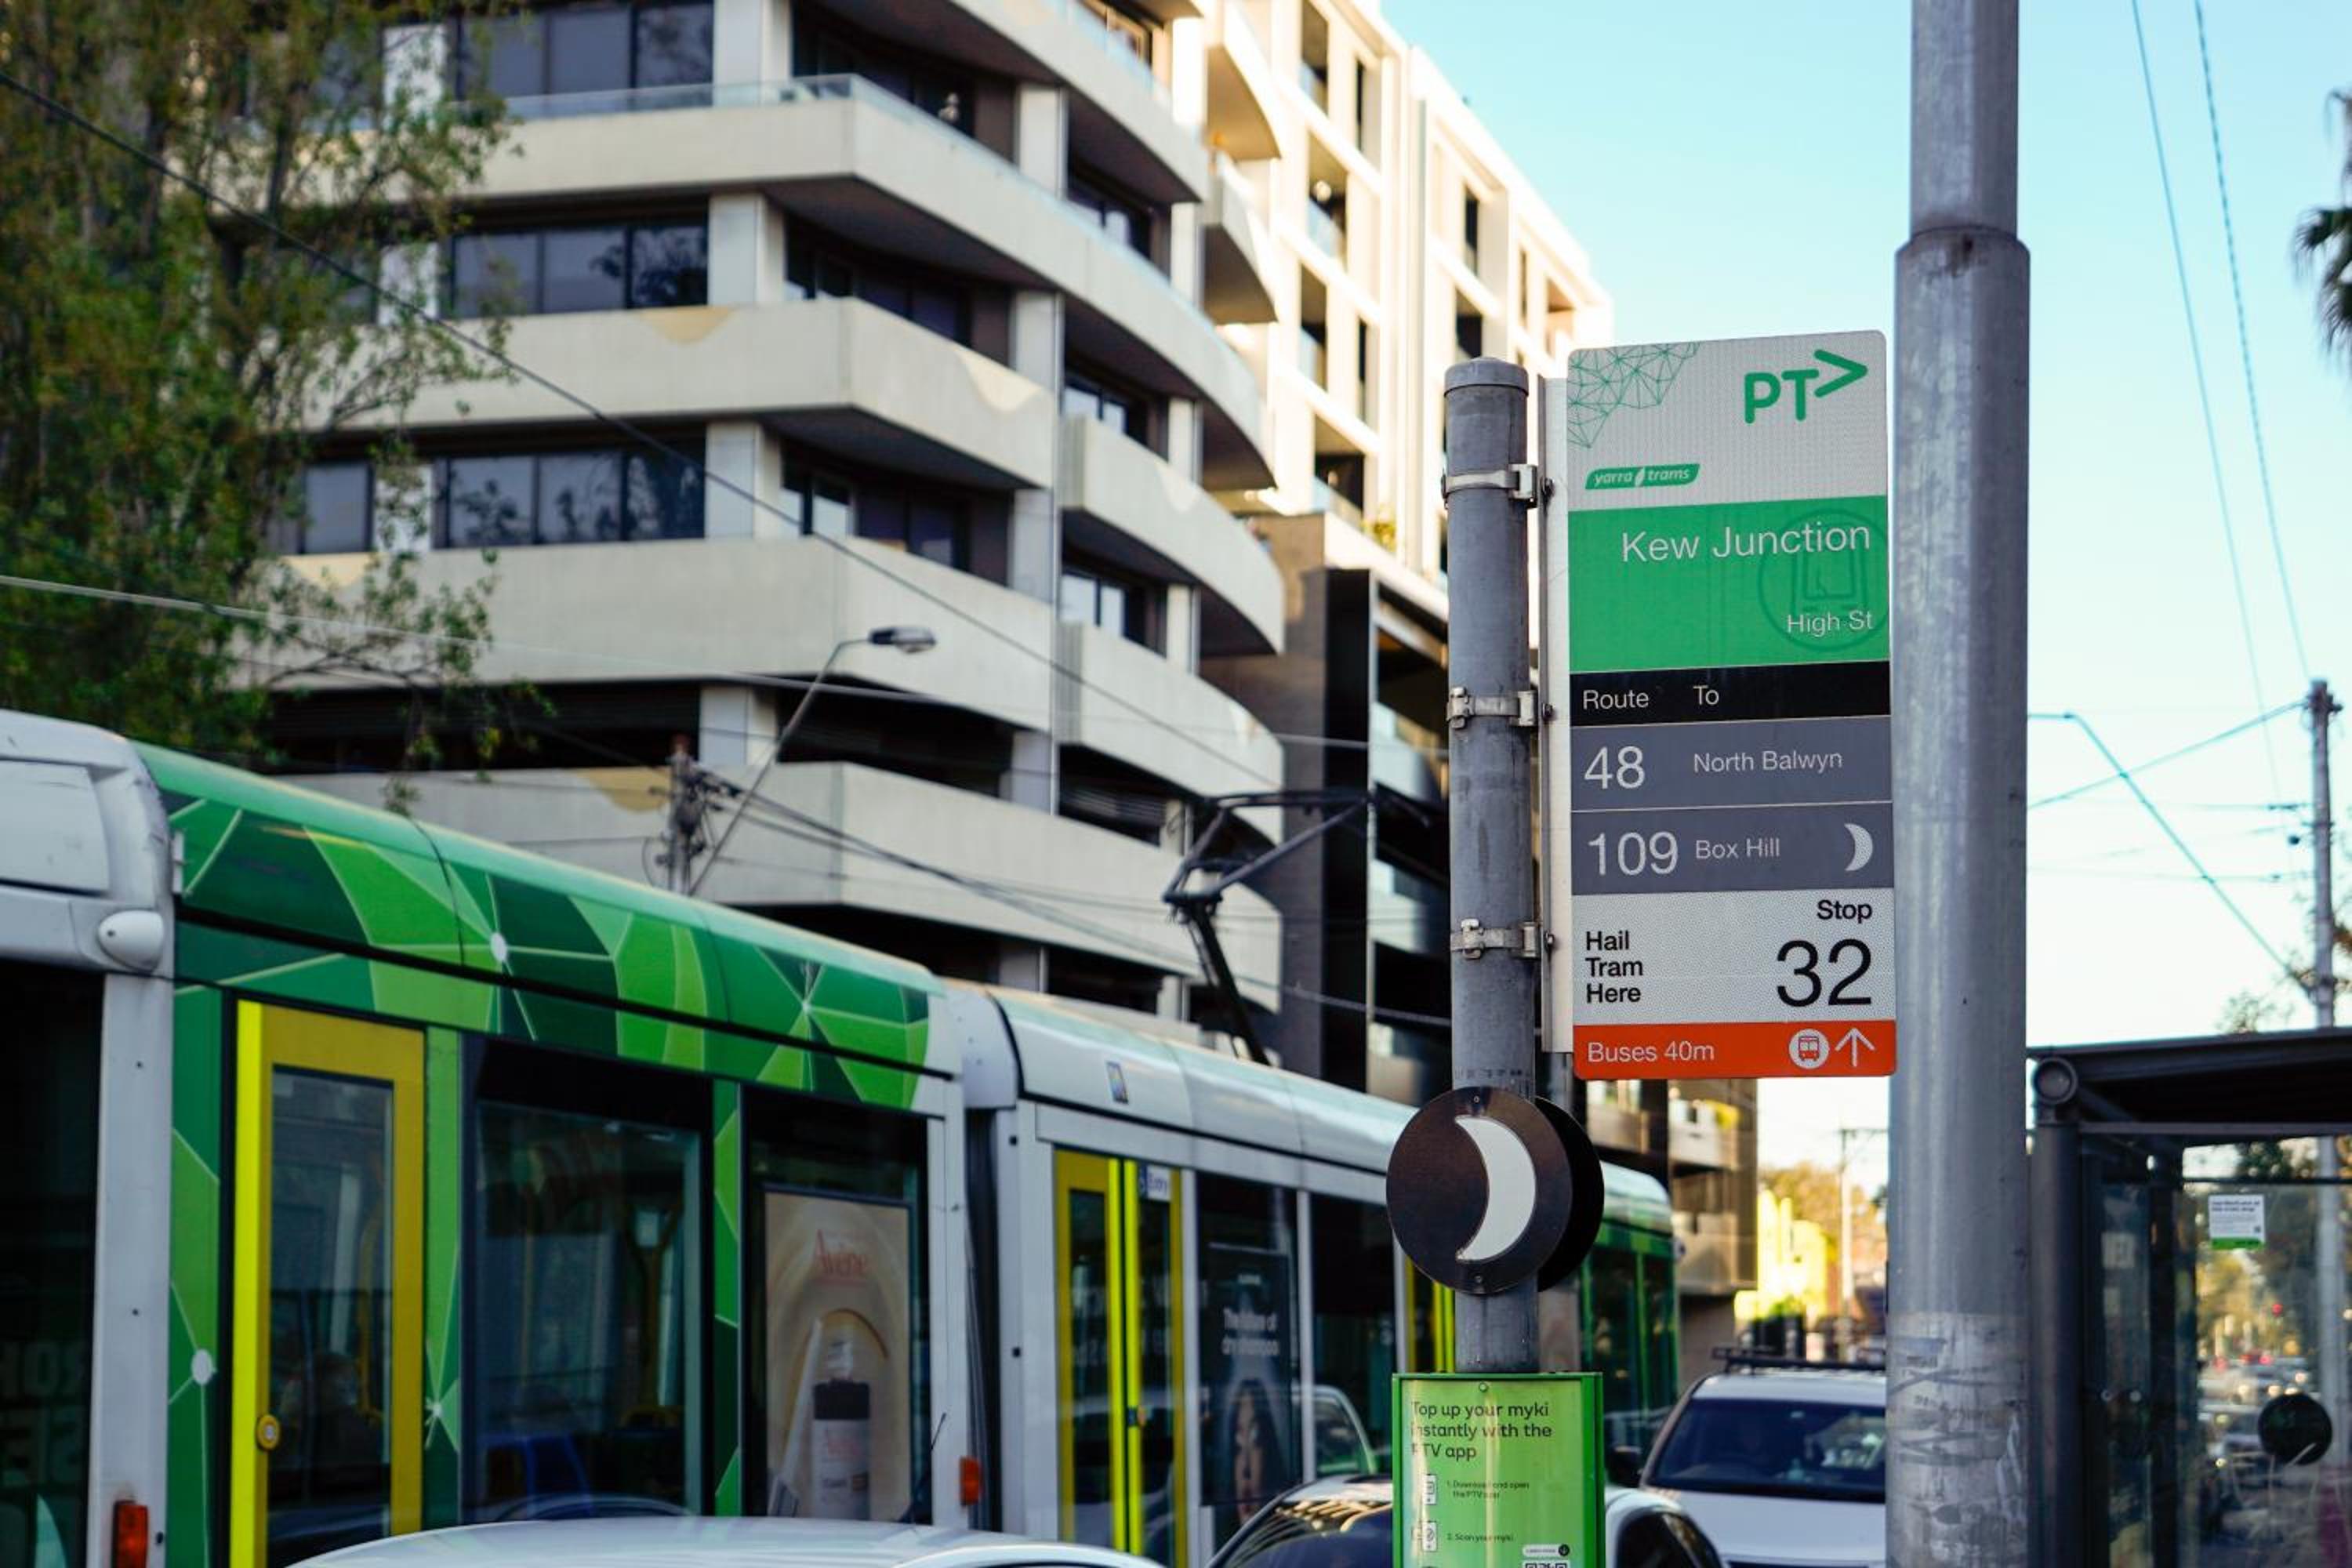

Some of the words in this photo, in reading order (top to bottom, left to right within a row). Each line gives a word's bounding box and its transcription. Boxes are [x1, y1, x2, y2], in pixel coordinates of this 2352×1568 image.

[1595, 472, 1632, 488] yarra
[1648, 468, 1690, 481] trams
[1621, 530, 1700, 563] Kew
[1713, 521, 1871, 559] Junction
[1788, 614, 1840, 637] High
[1849, 610, 1872, 630] St
[1582, 688, 1650, 710] Route
[1693, 684, 1719, 706] To
[1584, 746, 1646, 790] 48
[1693, 750, 1755, 775] North
[1762, 749, 1842, 775] Balwyn
[1588, 830, 1679, 877] 109
[1695, 840, 1738, 860] Box
[1746, 838, 1780, 858] Hill
[1817, 899, 1873, 924] Stop
[1585, 930, 1630, 952] Hail
[1585, 956, 1644, 978] Tram
[1777, 938, 1872, 1008] 32
[1586, 983, 1642, 1004] Here
[1587, 1040, 1657, 1063] Buses
[1664, 1040, 1715, 1062] 40m
[1411, 1401, 1437, 1419] Top
[1442, 1405, 1461, 1420] up
[1465, 1405, 1503, 1420] your
[1508, 1401, 1549, 1421] myki
[1523, 1422, 1552, 1438] the
[1445, 1446, 1477, 1461] app
